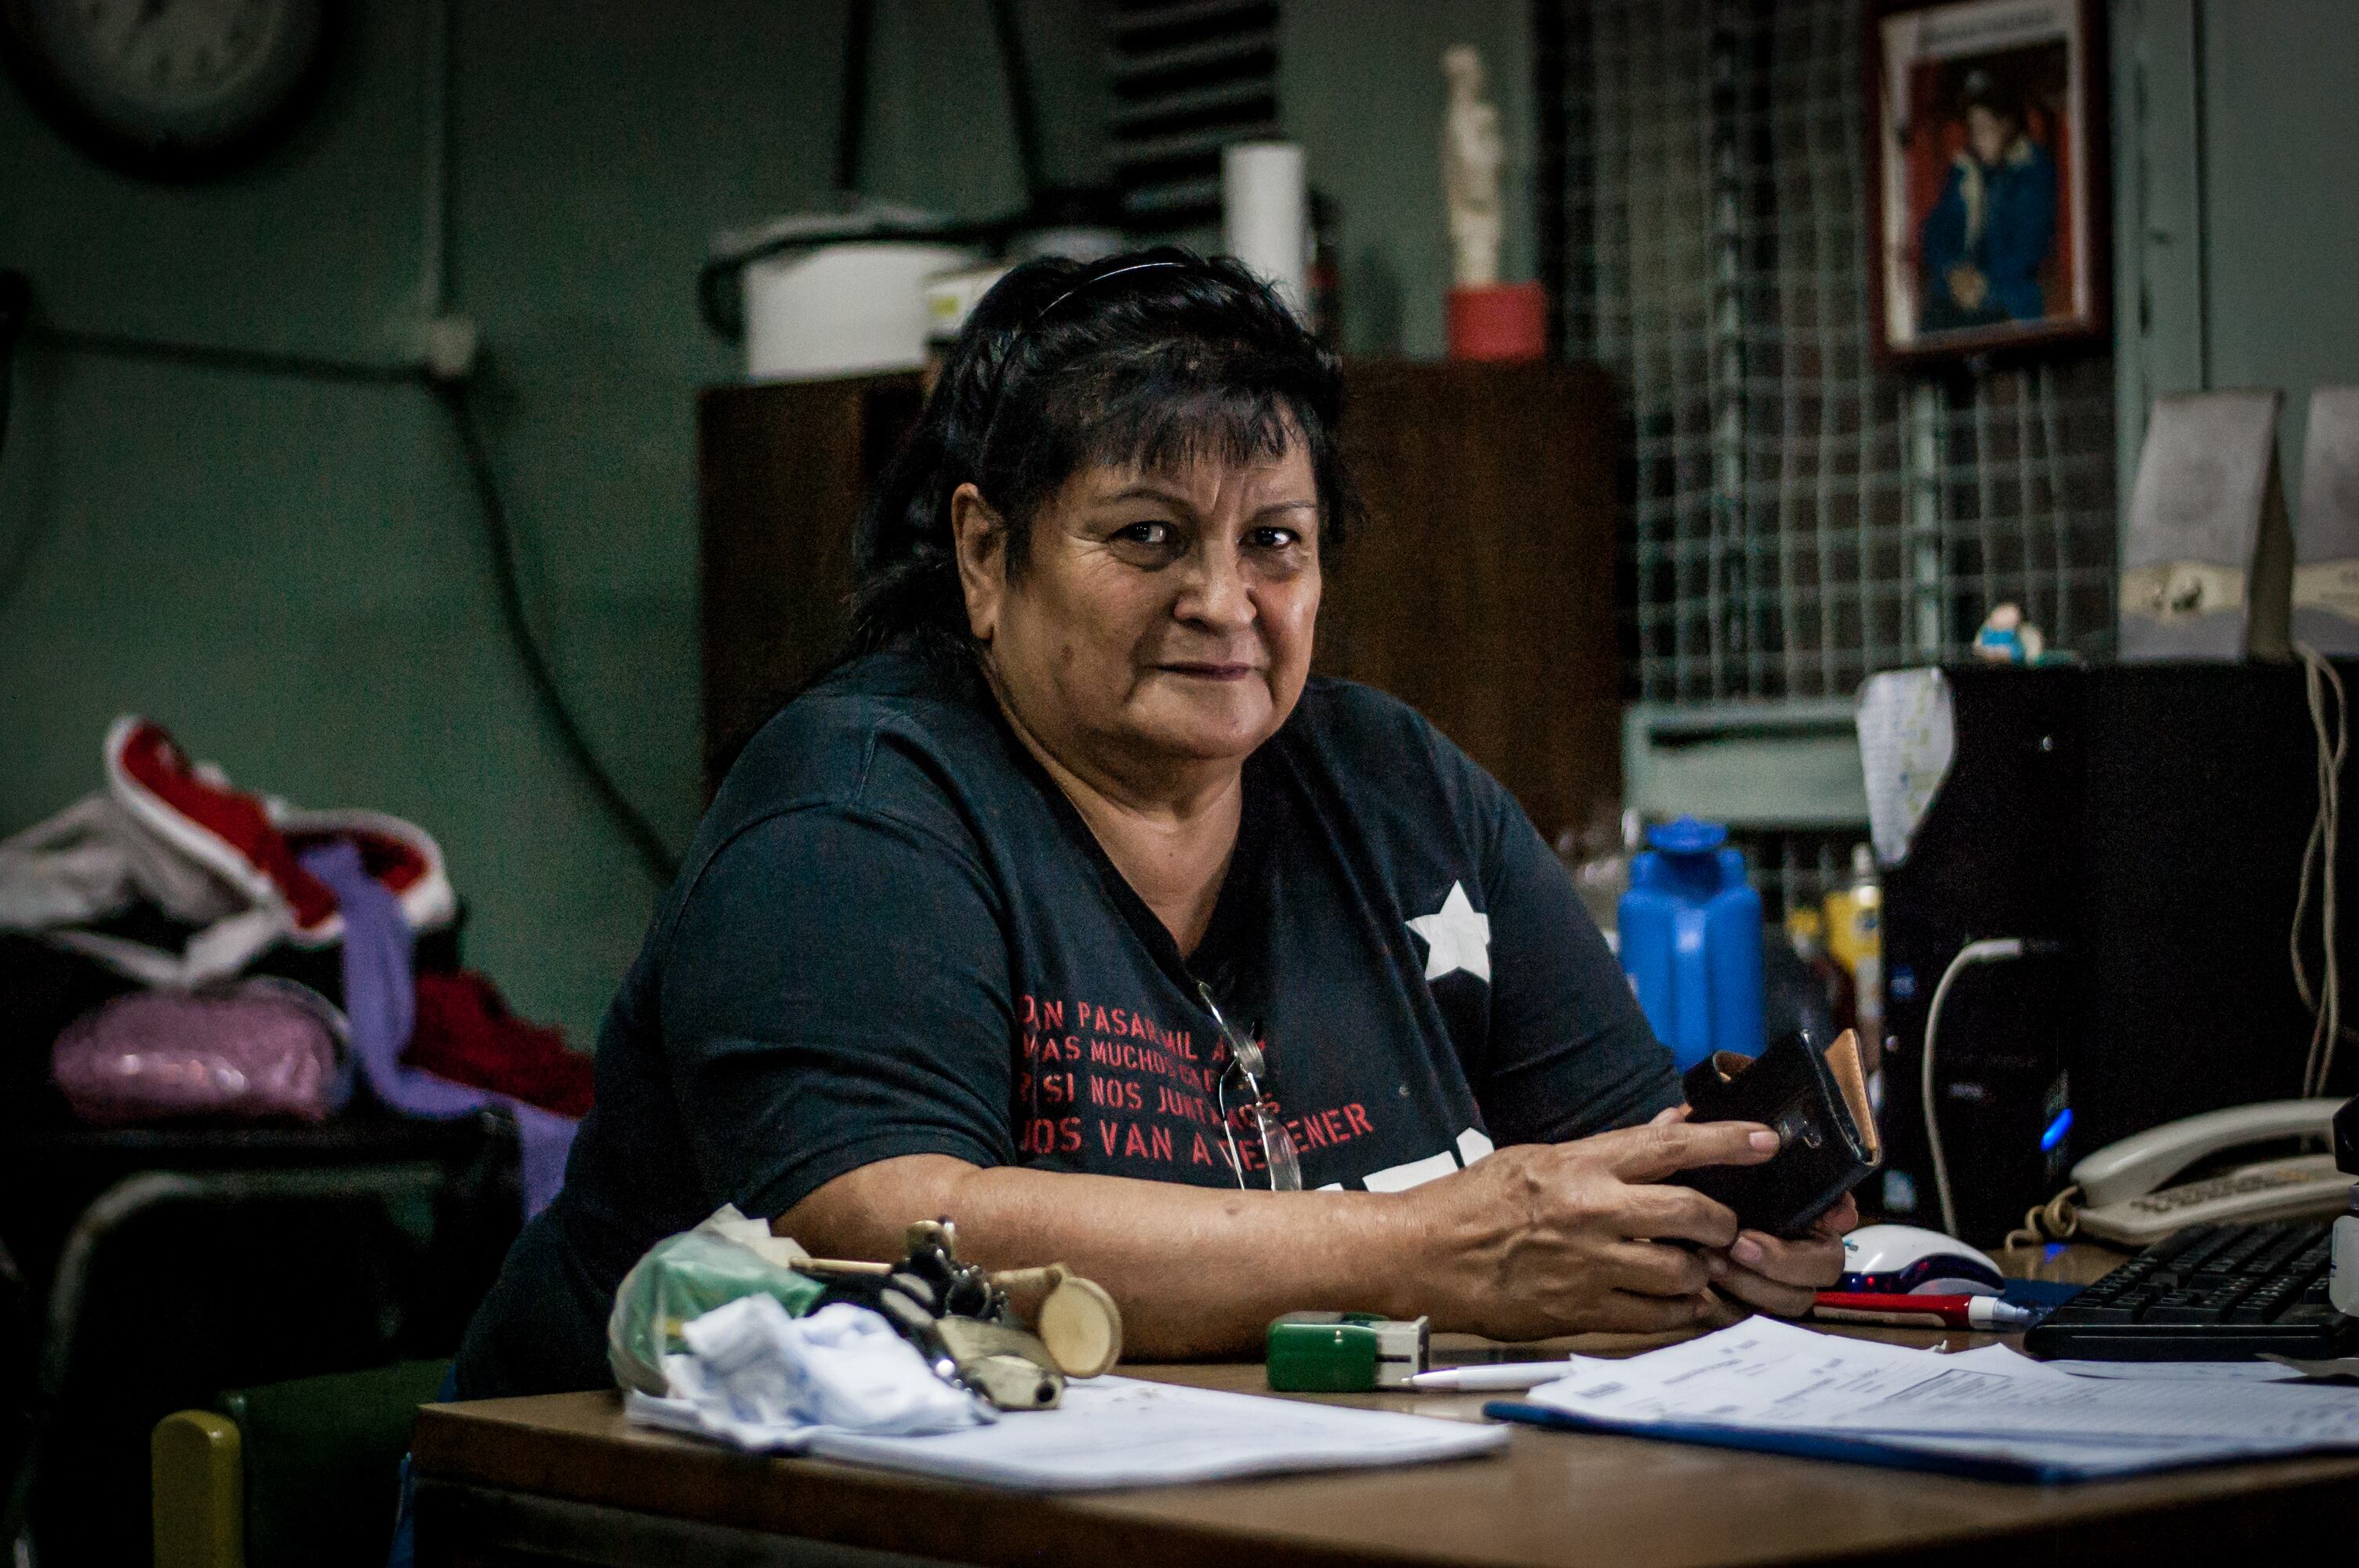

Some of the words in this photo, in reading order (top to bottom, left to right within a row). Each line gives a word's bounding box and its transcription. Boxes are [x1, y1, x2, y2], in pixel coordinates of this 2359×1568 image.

[1043, 1072, 1074, 1103] SI
[1091, 1073, 1143, 1112] NOS
[1099, 1119, 1173, 1163] VAN
[1192, 1131, 1213, 1167] A
